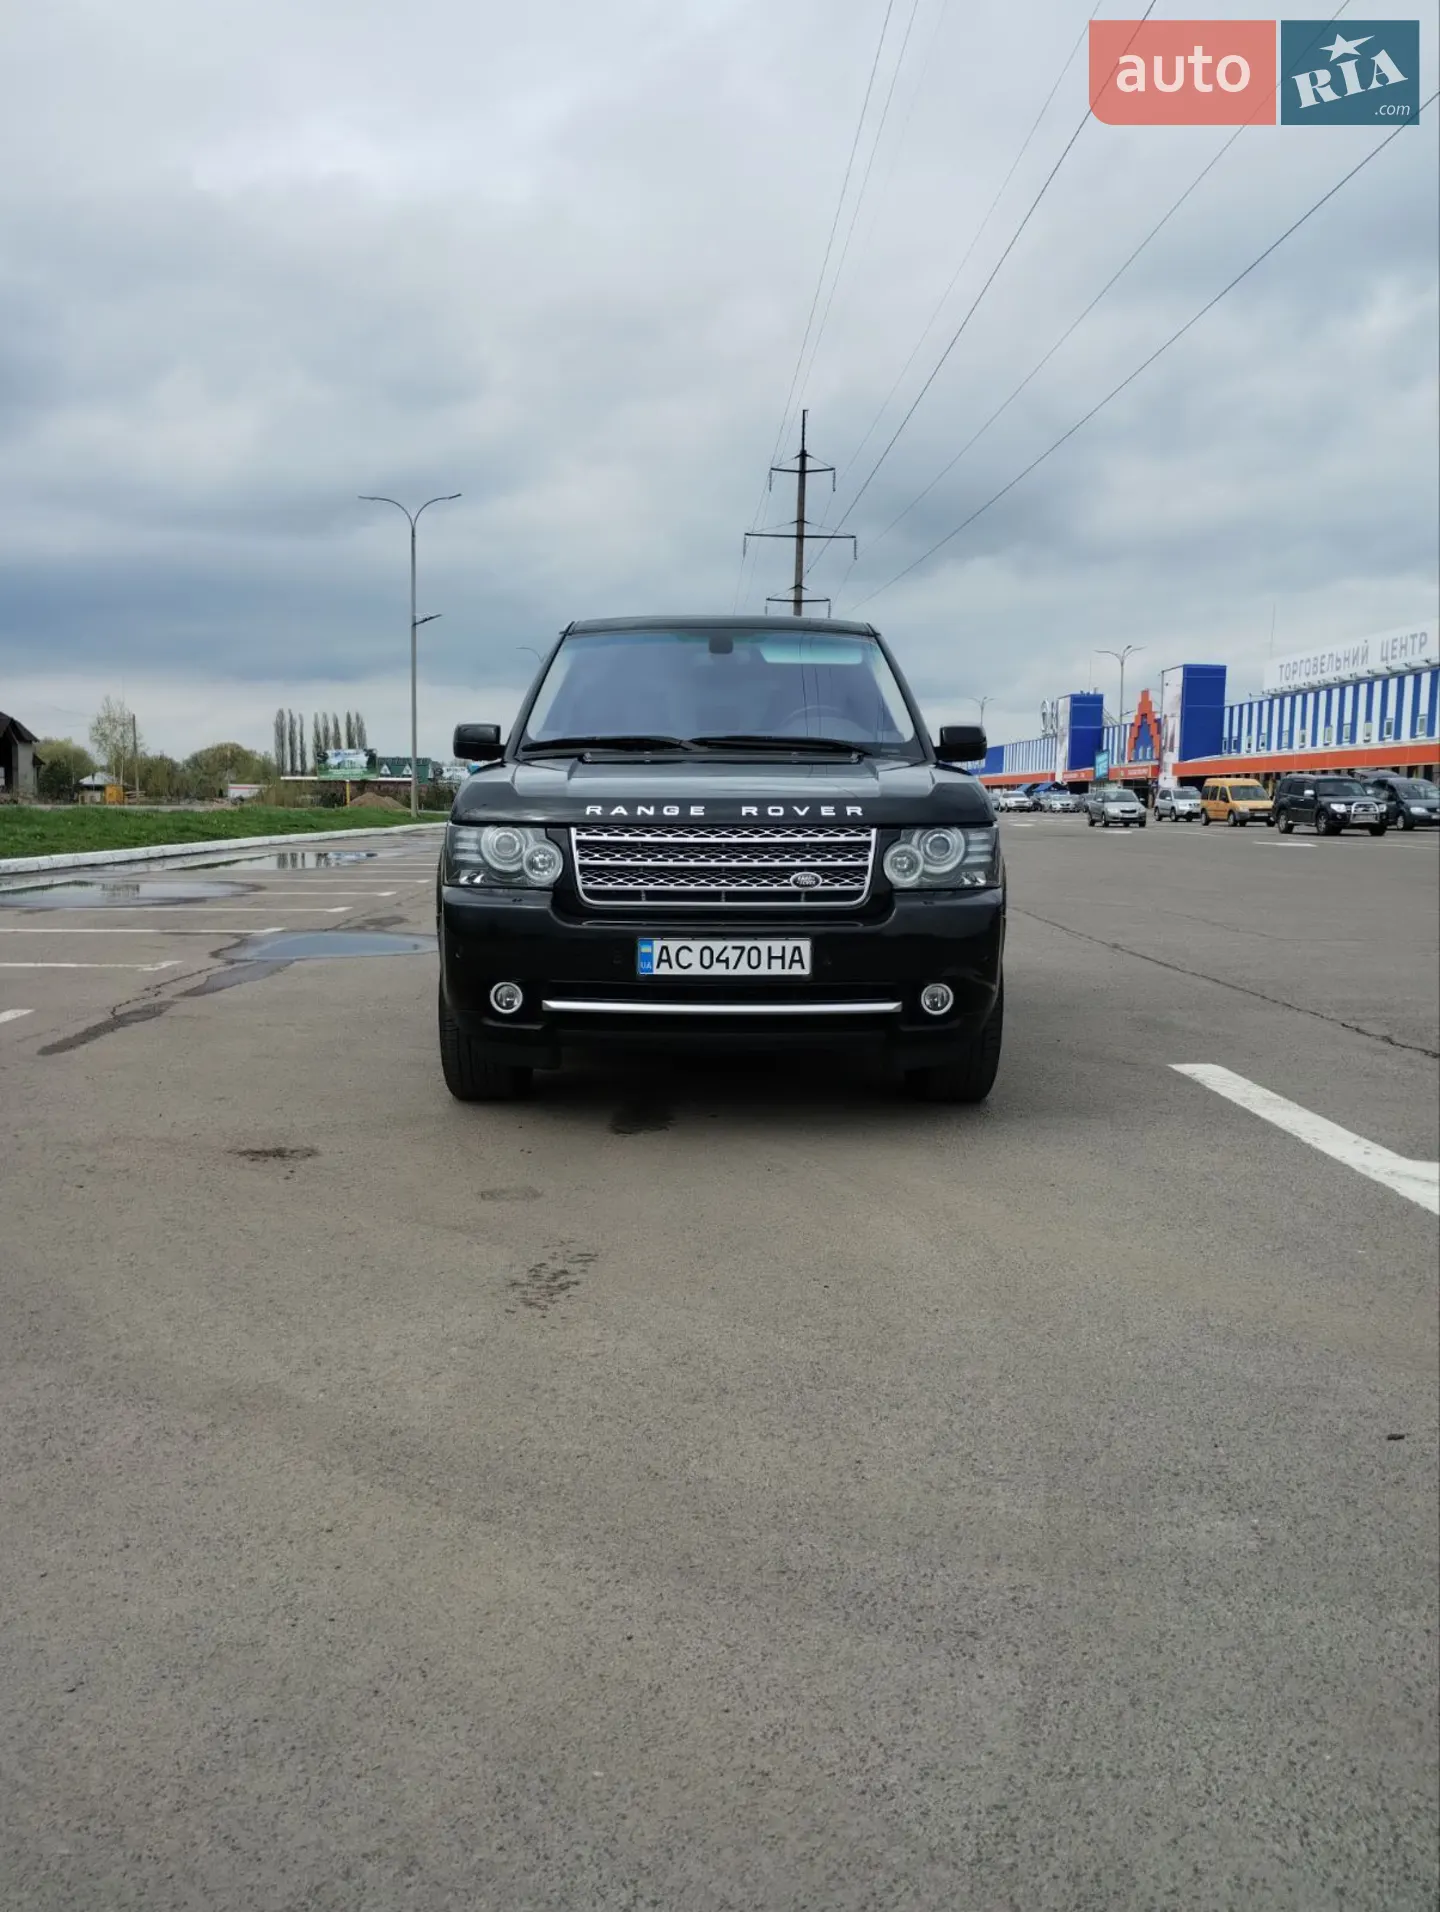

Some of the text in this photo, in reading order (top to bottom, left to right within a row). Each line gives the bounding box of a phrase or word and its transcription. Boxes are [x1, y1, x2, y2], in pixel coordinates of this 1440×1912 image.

[1279, 632, 1428, 682] ТОРГОВЕЛЬНИЙ ЦЕНТР
[586, 805, 863, 816] RANGE ROVER
[640, 961, 652, 969] UA
